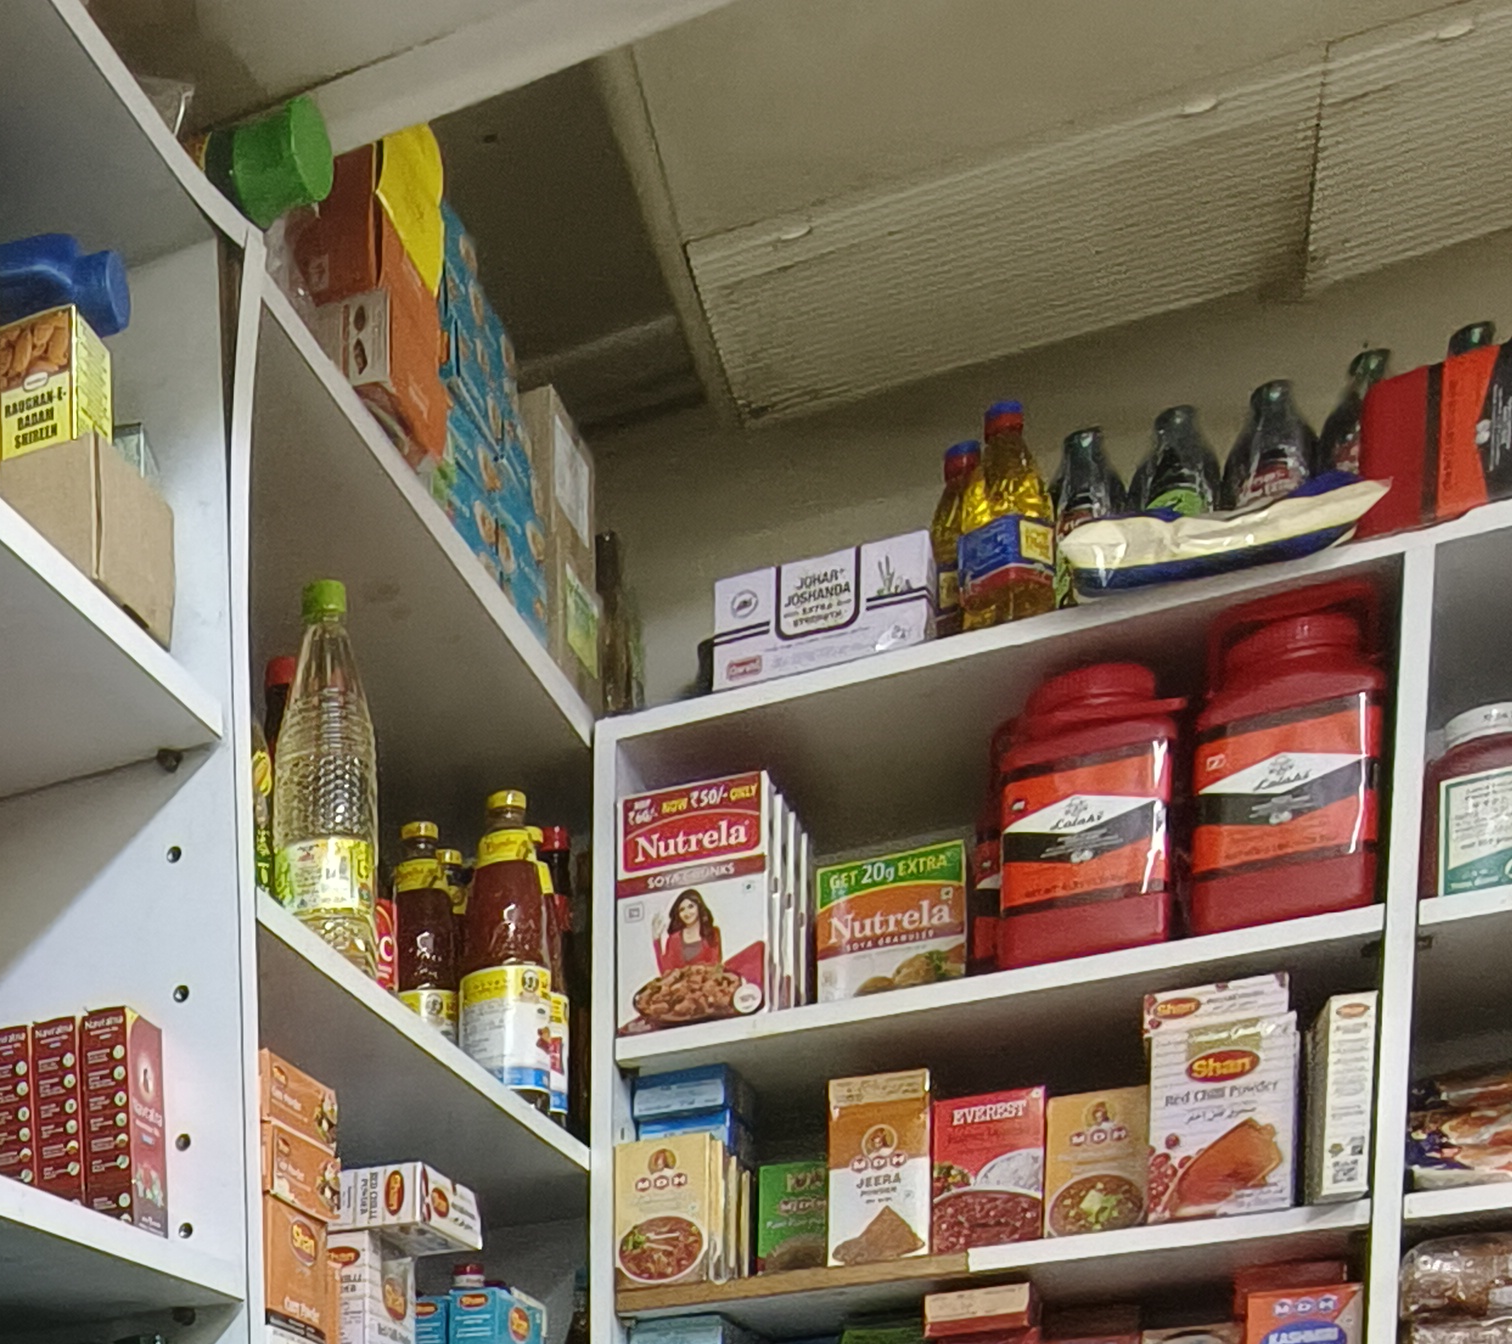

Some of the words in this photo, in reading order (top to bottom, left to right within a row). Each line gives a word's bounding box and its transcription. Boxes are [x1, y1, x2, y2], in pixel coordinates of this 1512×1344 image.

[784, 581, 851, 608] JOSHANDA
[661, 798, 688, 814] NOW
[729, 784, 758, 802] ONLY
[634, 821, 748, 863] Nutrela
[647, 874, 678, 890] SOYA
[829, 870, 857, 890] GET
[861, 863, 895, 885] 20g
[897, 855, 948, 876] EXTRA
[828, 900, 953, 944] Nutrela
[1156, 999, 1201, 1017] Shan
[1191, 1054, 1255, 1079] Shan
[1164, 1092, 1190, 1106] Red
[1229, 1079, 1279, 1097] Powder
[952, 1100, 1027, 1126] EVEREST
[1069, 1127, 1129, 1146] MDH
[851, 1151, 908, 1172] MDH
[635, 1173, 687, 1192] MDH
[856, 1172, 902, 1189] JEERA
[1272, 1294, 1338, 1317] MDH
